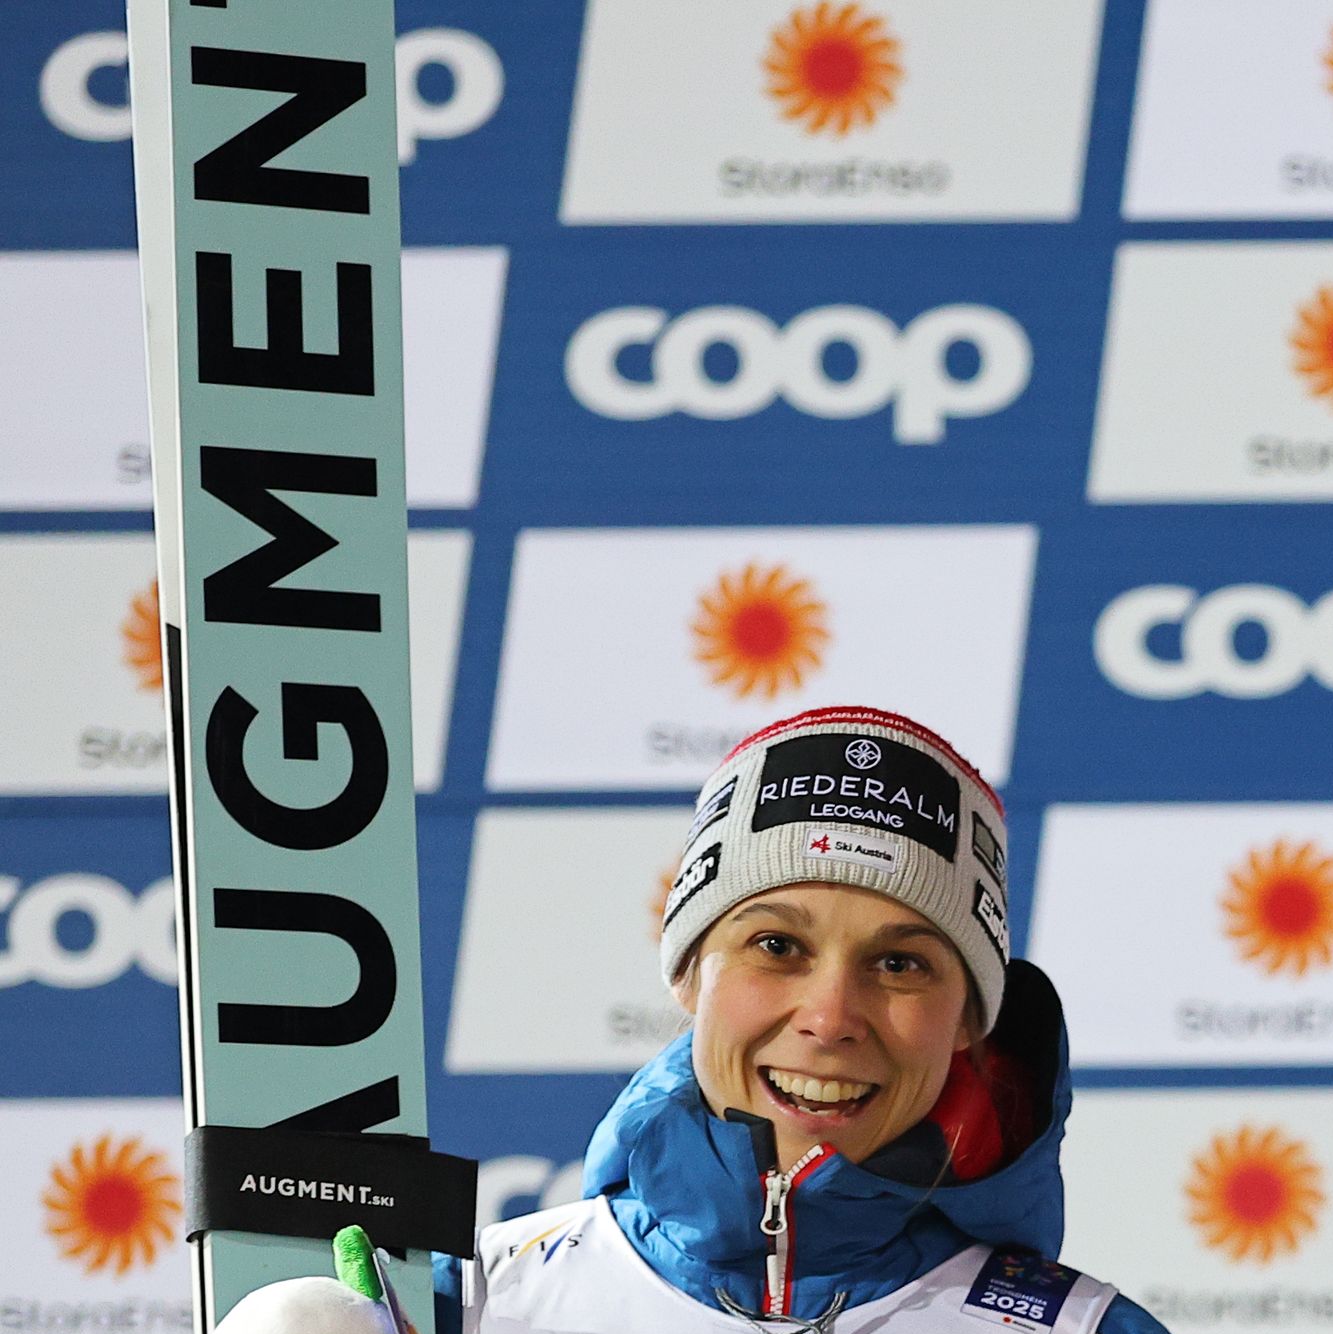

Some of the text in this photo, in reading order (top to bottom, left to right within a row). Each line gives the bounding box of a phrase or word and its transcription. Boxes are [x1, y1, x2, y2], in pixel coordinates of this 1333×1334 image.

[564, 304, 1034, 445] coop
[189, 0, 404, 1261] UGMEN
[760, 774, 955, 834] RIEDERALM
[809, 803, 905, 829] LEOGANG
[834, 840, 893, 863] Ski Austria
[239, 1173, 395, 1208] AUGMENT.SKI
[980, 1291, 1046, 1320] 2025
